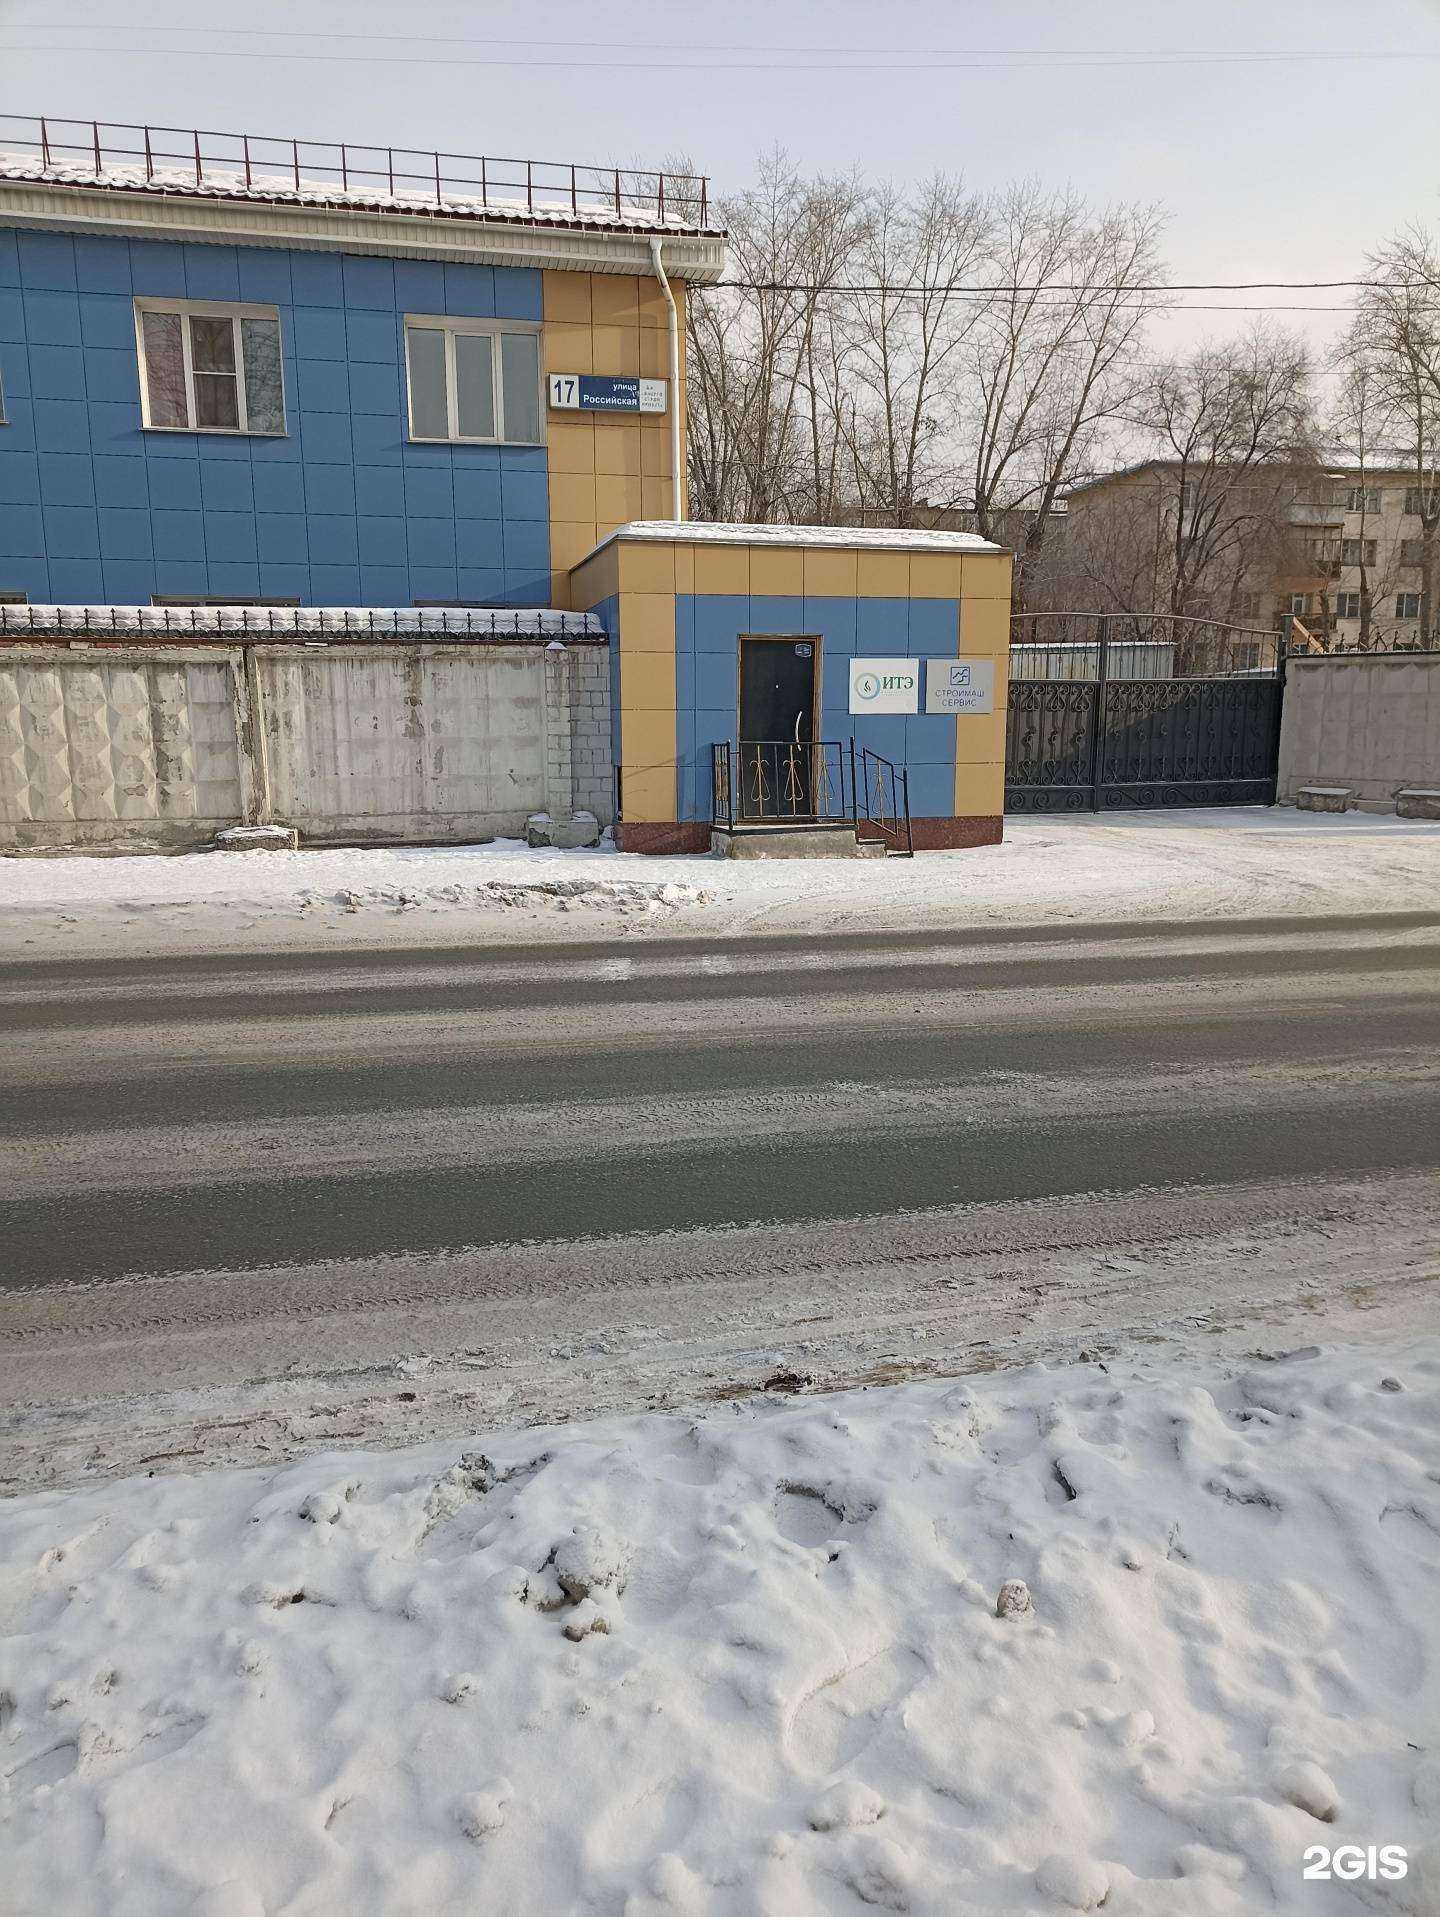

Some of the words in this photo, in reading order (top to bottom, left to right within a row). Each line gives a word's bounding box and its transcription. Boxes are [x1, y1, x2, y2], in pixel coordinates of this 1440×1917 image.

[554, 379, 575, 404] 17
[613, 383, 637, 392] улица
[583, 394, 638, 406] Российская
[882, 676, 914, 690] ИТЭ
[942, 699, 977, 707] СЕРВИС
